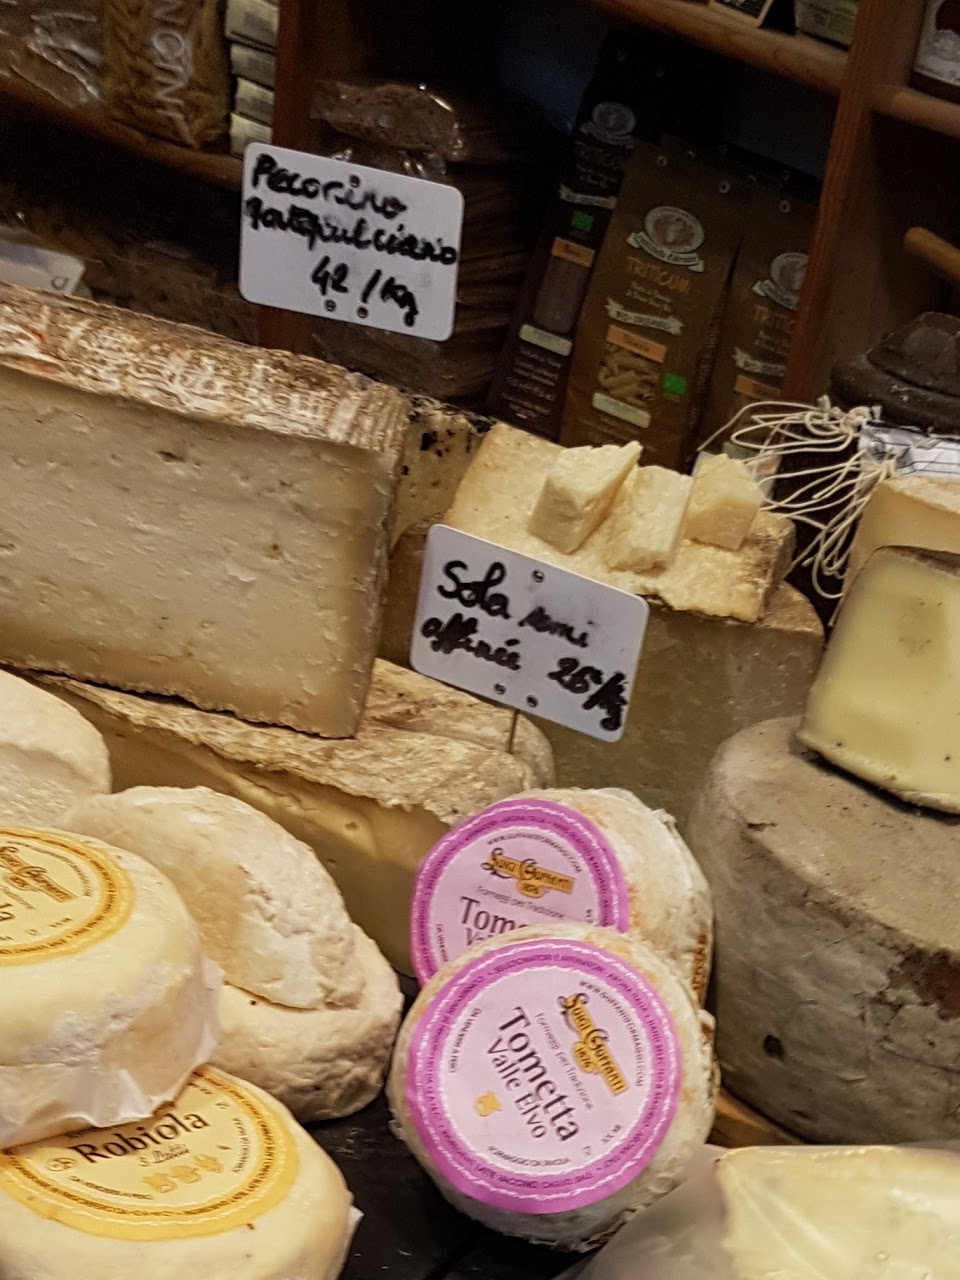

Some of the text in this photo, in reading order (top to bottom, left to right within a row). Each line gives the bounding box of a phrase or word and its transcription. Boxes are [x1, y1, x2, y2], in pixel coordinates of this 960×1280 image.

[252, 153, 407, 219] Pecorino
[311, 256, 348, 295] 42
[487, 1036, 548, 1140] Valle Elvo
[498, 1006, 580, 1142] Tometta
[68, 1111, 211, 1164] Robiola
